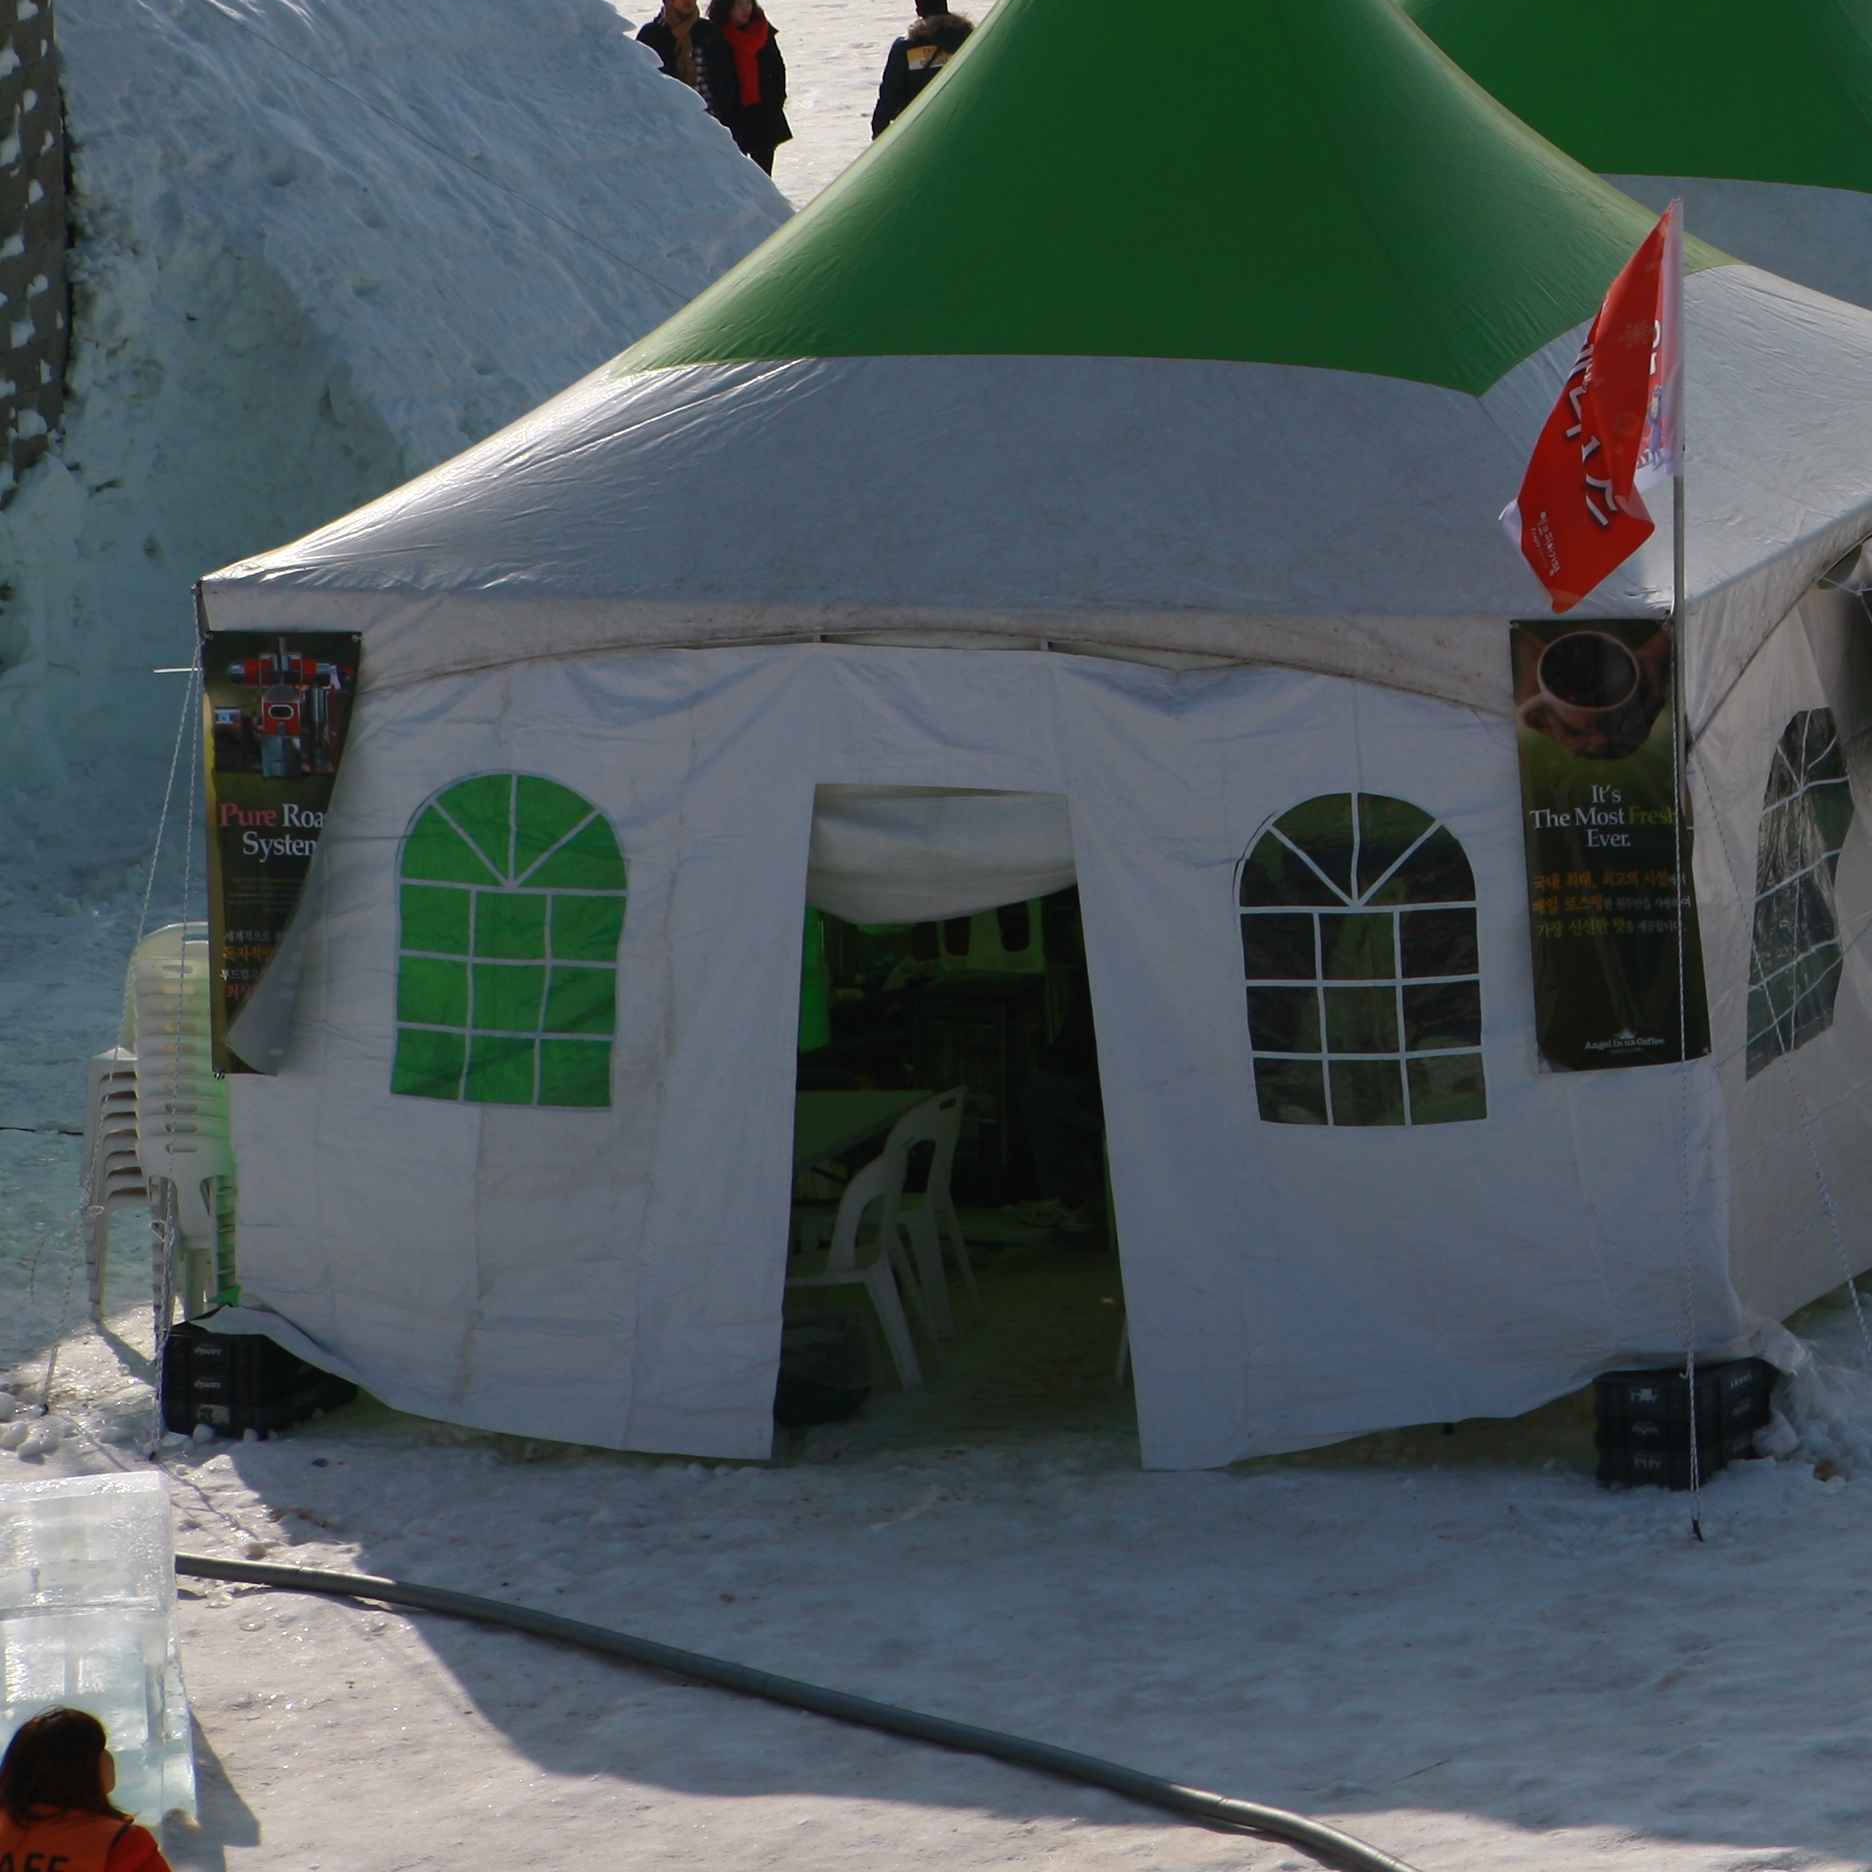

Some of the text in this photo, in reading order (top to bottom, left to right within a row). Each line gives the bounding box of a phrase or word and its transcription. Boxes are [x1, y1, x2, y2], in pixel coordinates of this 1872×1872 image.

[1591, 784, 1622, 804] It's
[218, 803, 280, 828] Pure
[1529, 808, 1571, 829] The
[1574, 807, 1625, 826] Most
[1585, 828, 1631, 848] Ever.
